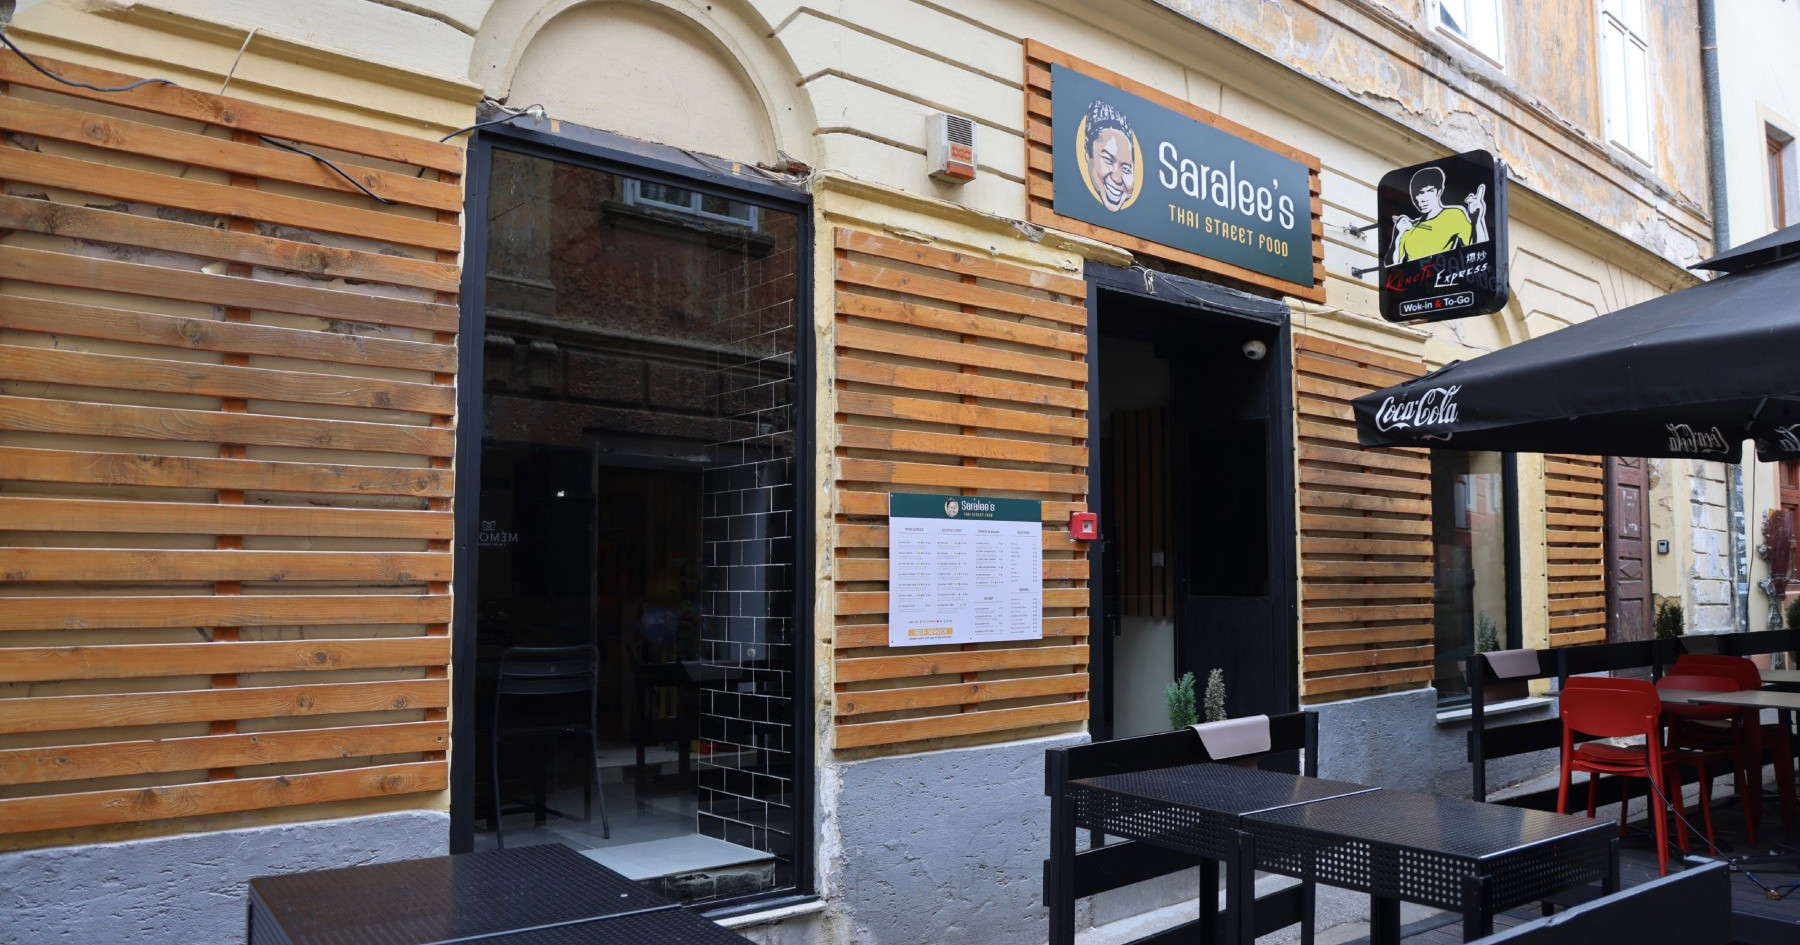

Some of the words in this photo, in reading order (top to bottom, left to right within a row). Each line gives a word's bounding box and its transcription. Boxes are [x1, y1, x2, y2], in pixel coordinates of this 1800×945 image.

[1158, 141, 1295, 230] Saralee's
[1168, 203, 1200, 230] THAI
[1205, 216, 1254, 246] STREET
[1259, 233, 1289, 257] FOOD
[1403, 300, 1433, 313] Wok-in
[1434, 298, 1443, 308] &
[1443, 295, 1470, 307] To-Go
[1375, 383, 1463, 432] Coca-Cola
[961, 500, 996, 512] Saralee's
